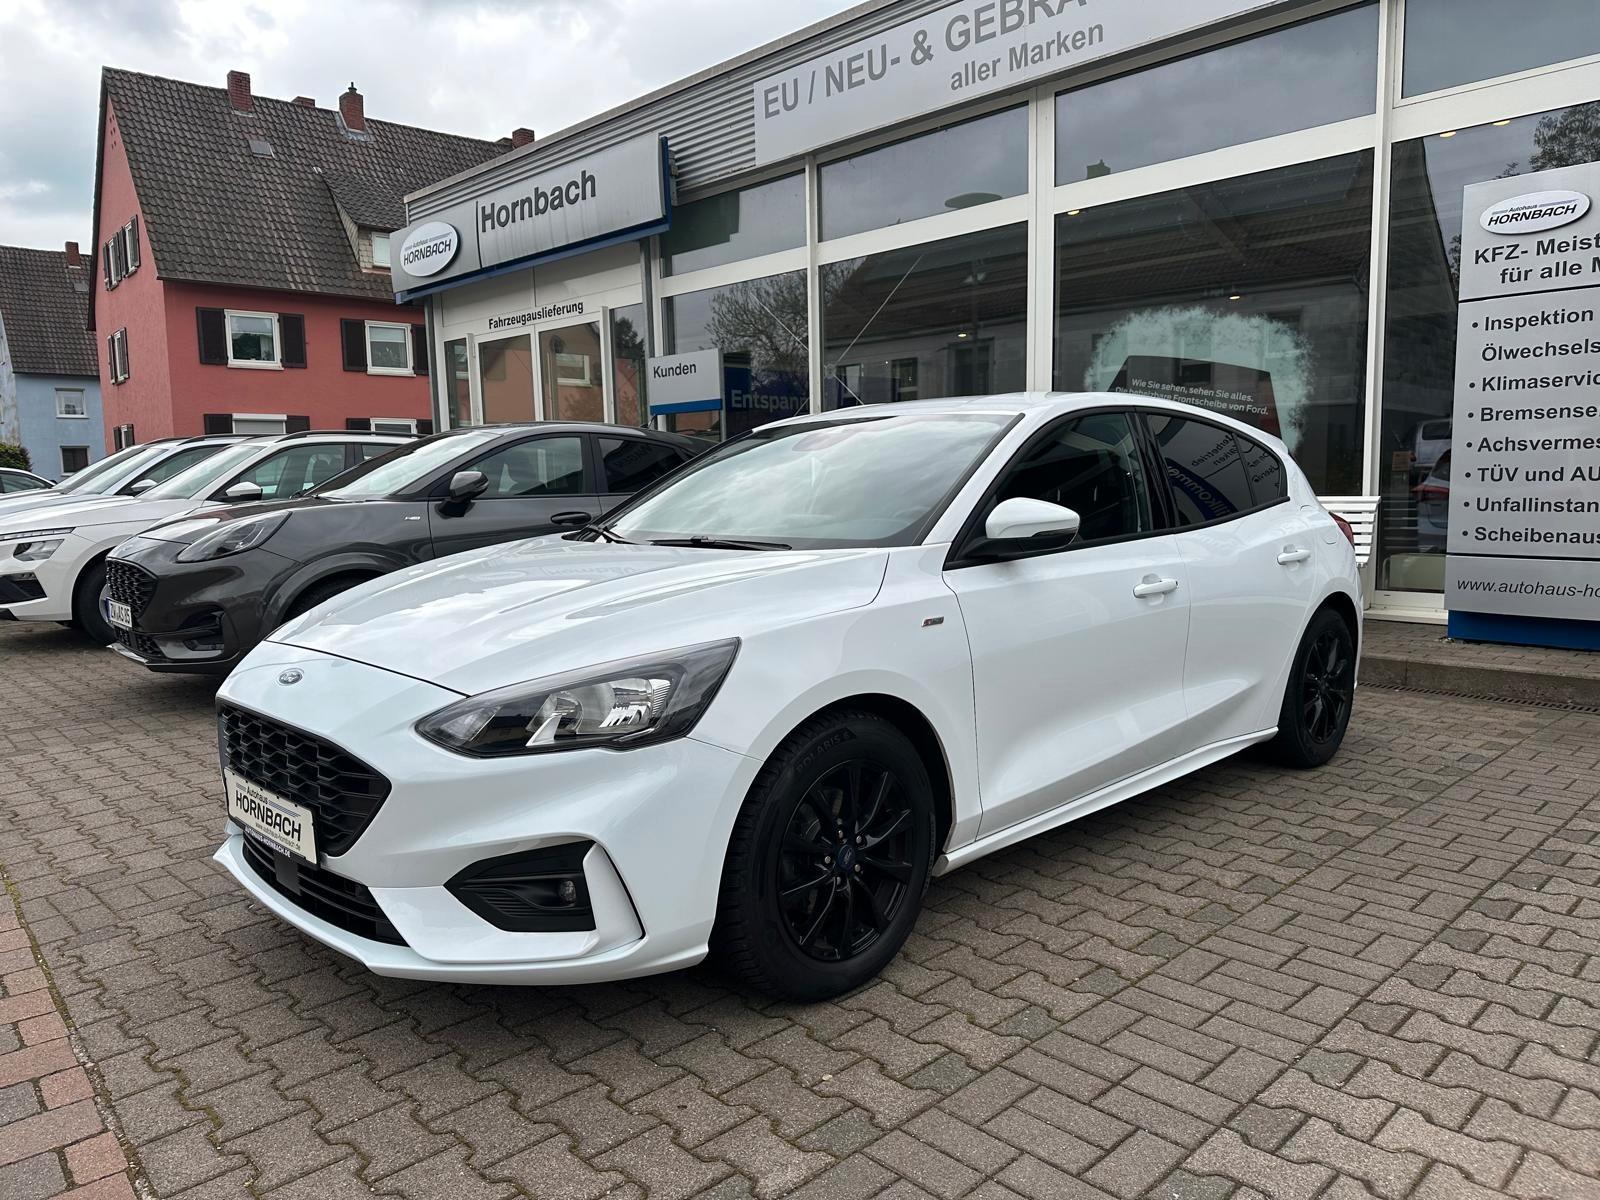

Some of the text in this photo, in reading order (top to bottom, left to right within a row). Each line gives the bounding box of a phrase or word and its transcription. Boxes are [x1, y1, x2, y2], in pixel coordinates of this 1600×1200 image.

[950, 23, 1104, 91] aller Marken
[763, 77, 799, 120] EU
[825, 44, 900, 98] NEU-
[910, 29, 935, 66] &
[481, 170, 596, 233] Hornbach
[1508, 204, 1538, 213] Autohaus
[1487, 204, 1578, 227] HORNBACH
[403, 238, 452, 266] HORNBACH
[1474, 233, 1600, 265] KFZ- Meist
[1500, 267, 1533, 284] für
[1540, 260, 1582, 279] alle
[488, 301, 584, 330] Fahrzeugauslieferung
[1484, 309, 1594, 332] Inspektion
[1482, 338, 1600, 361] Ölwechsels
[653, 362, 697, 379] Kunden
[1482, 370, 1600, 392] Klimaservic
[1132, 378, 1254, 402] Wie Sie sehen, sehen Sie alles.
[1173, 394, 1227, 409] Frontscheibe
[1229, 403, 1244, 412] von
[1246, 404, 1269, 415] Ford.
[1477, 464, 1600, 482] TÜV und AU
[1476, 496, 1599, 513] Unfallinstan
[235, 789, 302, 842] HORNBACH
